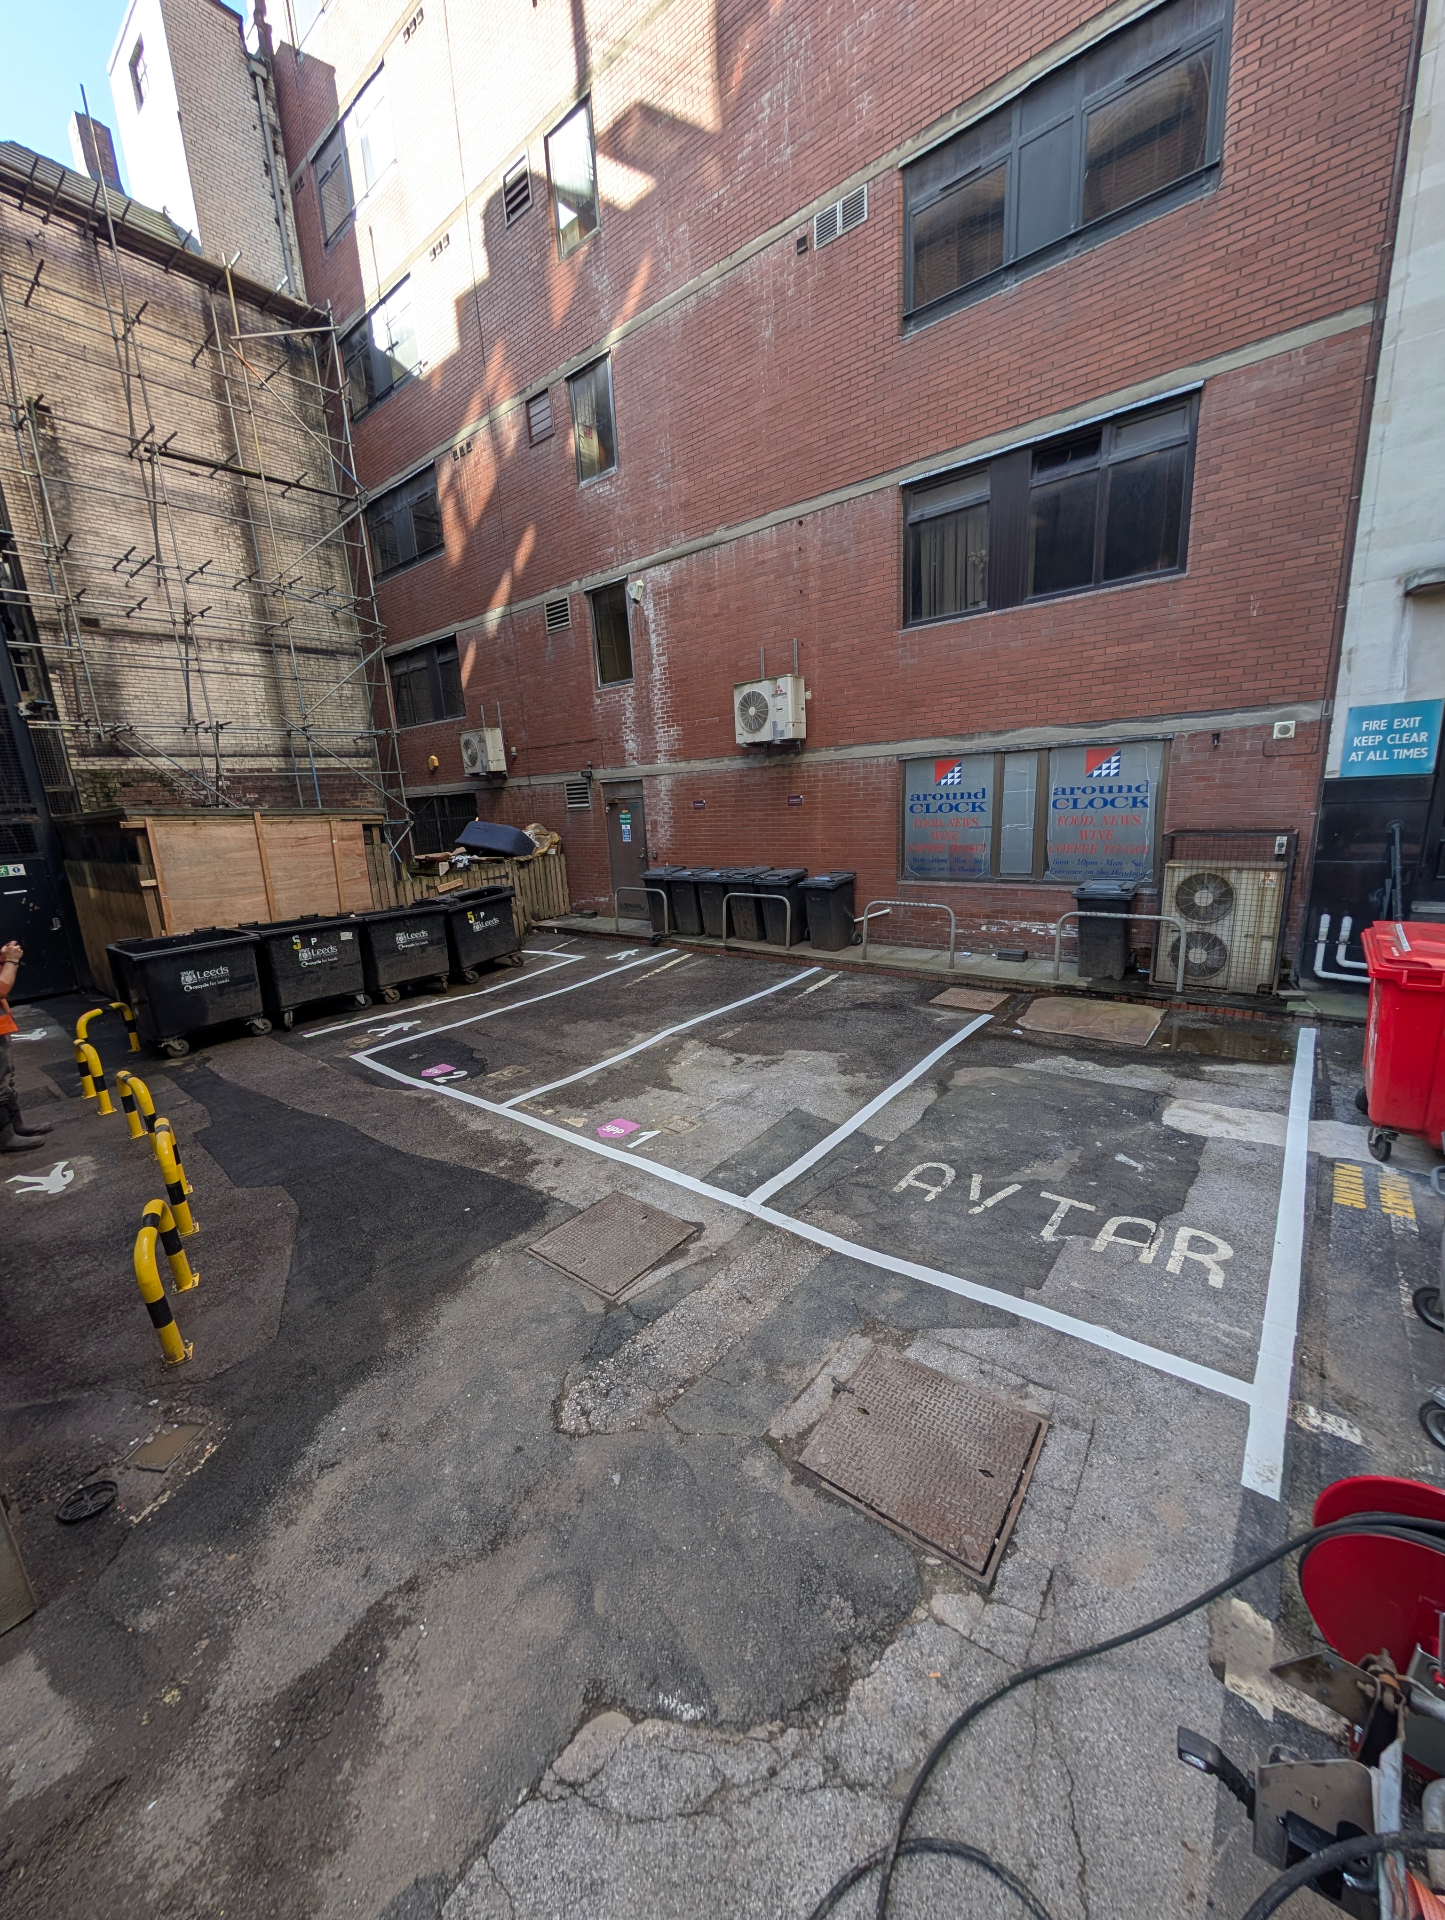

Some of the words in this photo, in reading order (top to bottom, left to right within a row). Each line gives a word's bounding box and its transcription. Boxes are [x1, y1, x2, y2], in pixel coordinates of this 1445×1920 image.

[1362, 719, 1388, 731] FIRE
[1393, 716, 1422, 729] EXIT
[1353, 735, 1383, 747] KEEP
[1386, 731, 1428, 745] CLEAR
[1348, 751, 1364, 762] AT
[1366, 750, 1389, 761] ALL
[1393, 747, 1429, 760] TIMES
[1053, 779, 1150, 796] around
[909, 787, 986, 802] around
[909, 801, 987, 814] CLOCK
[1052, 796, 1150, 810] CLOCK
[1057, 815, 1096, 827] FOOD,
[1100, 814, 1143, 827] NEWS,
[1079, 829, 1118, 841] WINE,
[907, 843, 946, 853] COFFEE
[950, 843, 965, 853] TO
[1048, 843, 1098, 854] COFFEE
[1104, 843, 1122, 854] TO
[1077, 858, 1098, 867] 10pm
[1096, 868, 1109, 876] the
[467, 910, 475, 924] 5
[479, 911, 485, 919] P
[481, 917, 500, 928] Leeds
[406, 929, 429, 940] Leeds
[291, 934, 302, 950] 5
[310, 937, 318, 946] P
[311, 945, 338, 957] Leeds
[196, 965, 229, 979] Leeds
[432, 1070, 468, 1083] 2
[626, 1130, 662, 1149] 1
[891, 1161, 1234, 1290] AVTAR
